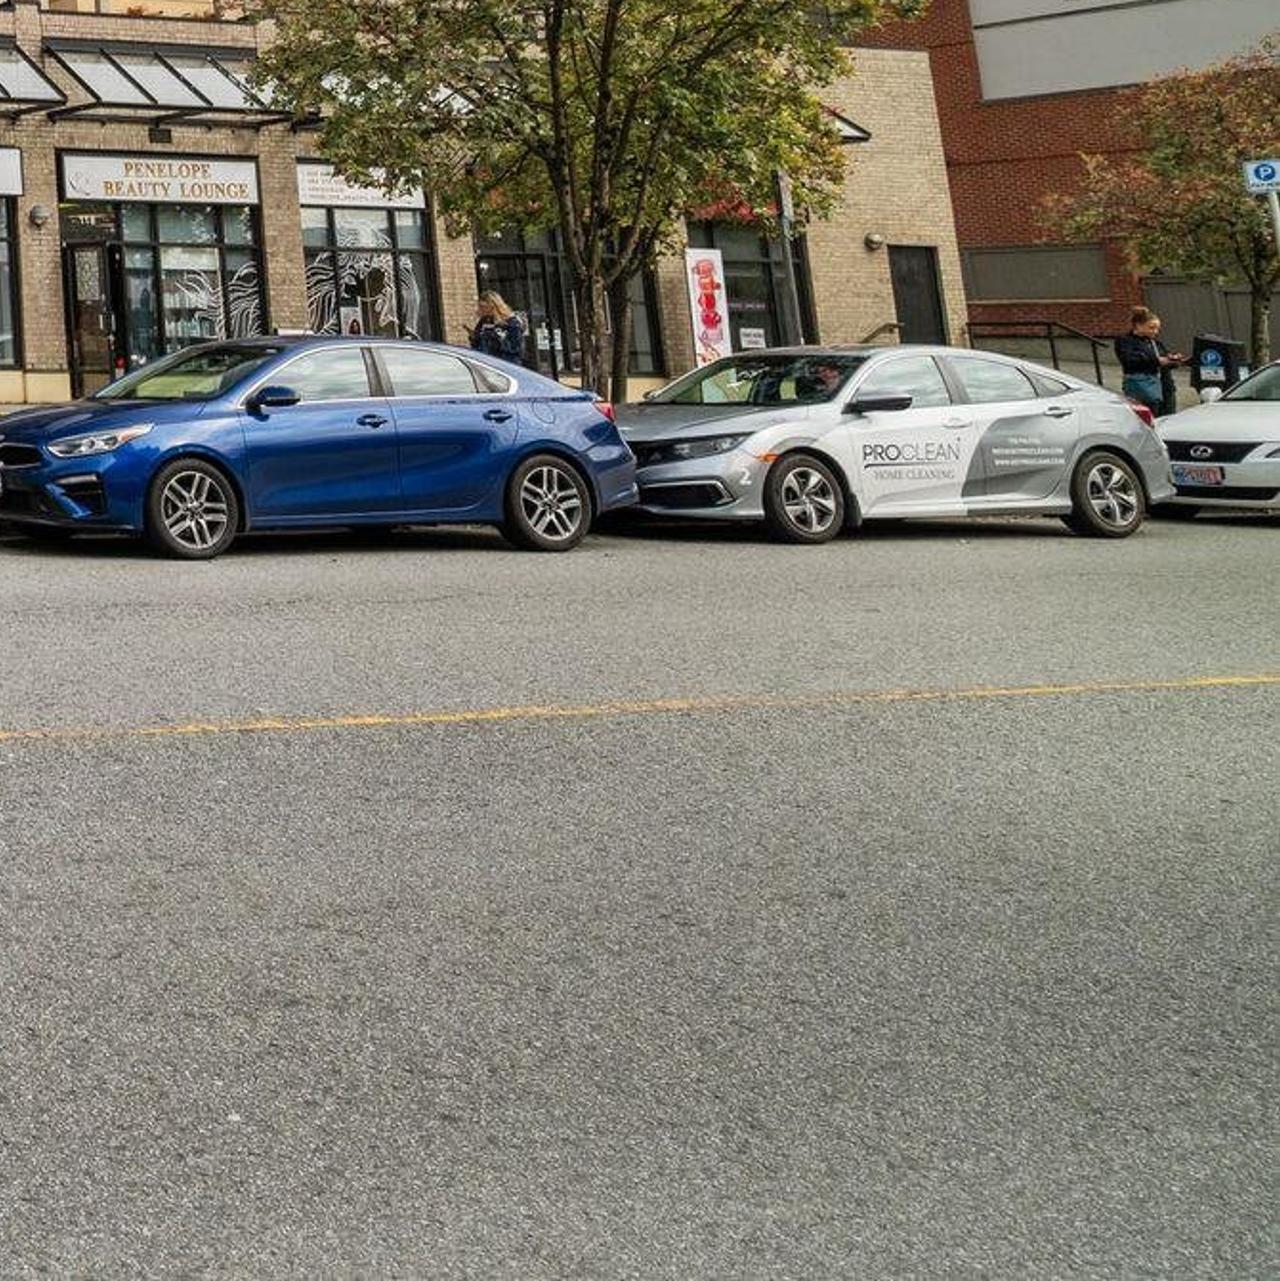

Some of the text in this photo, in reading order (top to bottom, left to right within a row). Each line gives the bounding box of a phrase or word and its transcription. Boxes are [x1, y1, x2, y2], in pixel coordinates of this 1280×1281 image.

[123, 161, 212, 179] PENELOPE
[103, 180, 251, 199] BEAUTY LOUNGE
[862, 442, 960, 461] PROCLEAN
